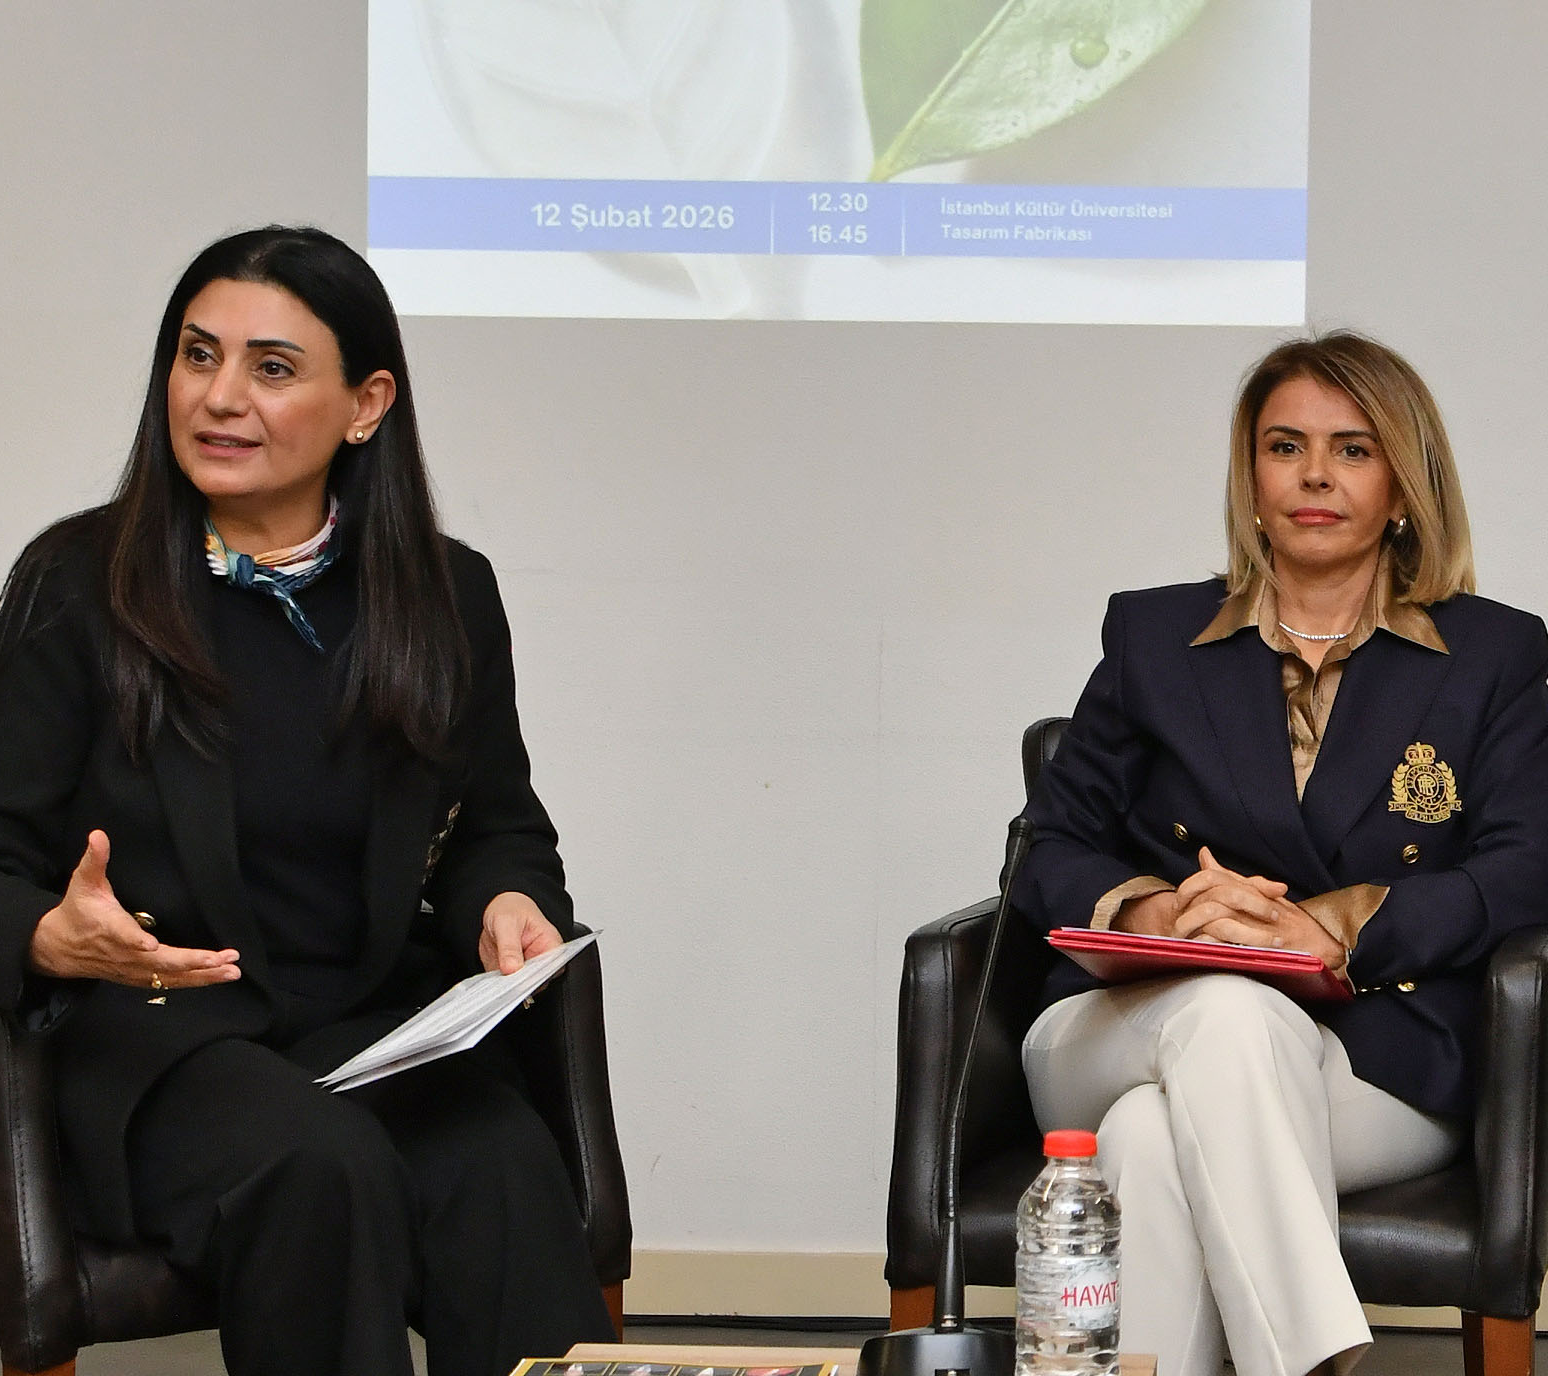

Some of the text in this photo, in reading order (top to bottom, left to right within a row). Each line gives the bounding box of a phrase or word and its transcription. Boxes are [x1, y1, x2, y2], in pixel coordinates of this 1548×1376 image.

[807, 193, 868, 212] 12.30
[940, 196, 1173, 219] İstanbul Kültür Üniversitesi
[530, 204, 735, 234] 12 Şubat 2026
[809, 225, 868, 245] 16.45
[941, 224, 1092, 243] Tasarım Fabrikası
[1061, 1280, 1119, 1307] HAYAT
